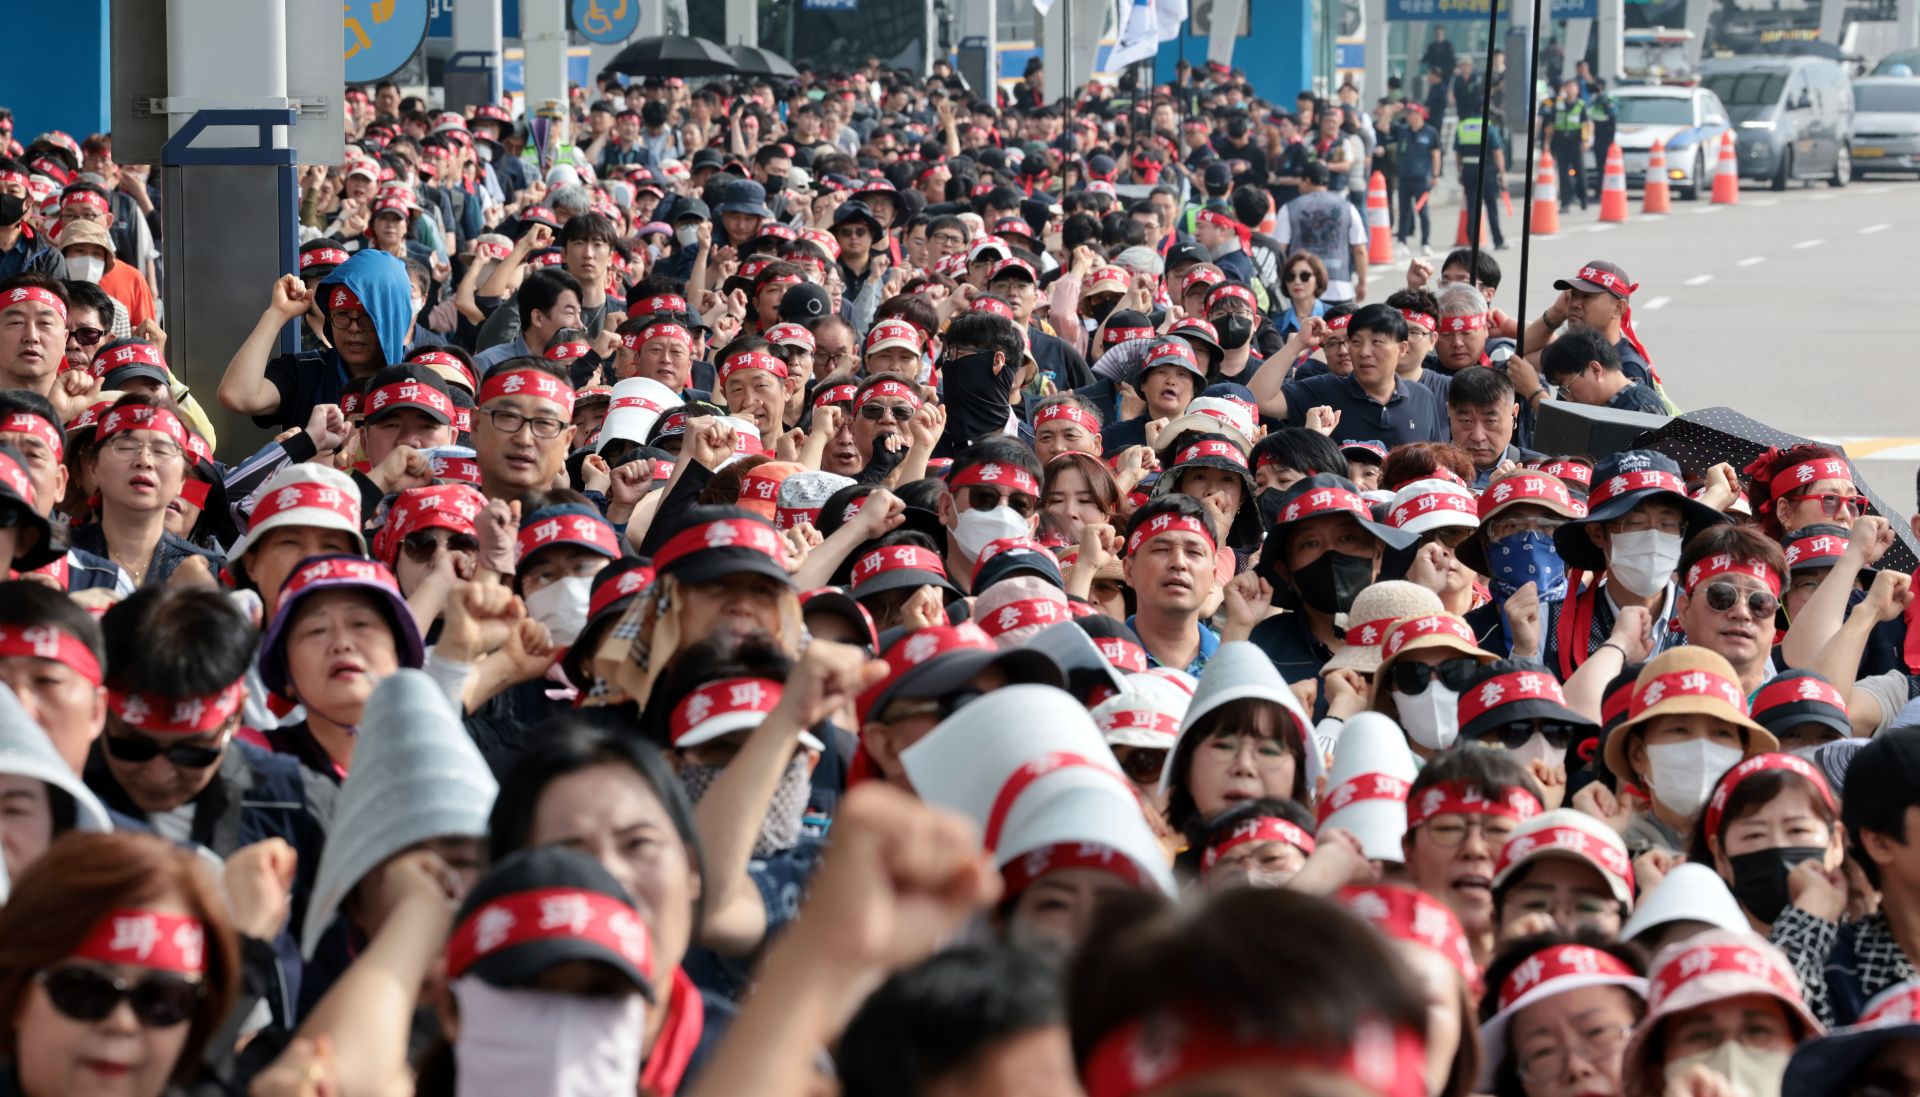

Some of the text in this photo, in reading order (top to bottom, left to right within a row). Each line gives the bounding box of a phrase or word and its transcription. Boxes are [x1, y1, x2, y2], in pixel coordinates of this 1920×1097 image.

[1583, 267, 1615, 286] 파업
[873, 327, 918, 344] 총파업
[94, 346, 160, 377] 총파업
[721, 352, 776, 377] 총파업
[1144, 344, 1188, 364] 총파업
[373, 384, 446, 410] 총파업
[861, 380, 920, 407] 총파업
[103, 407, 182, 441] 총파업
[1185, 442, 1246, 466] 총파업
[1619, 461, 1651, 473] FONDEST
[979, 462, 1040, 497] 총파
[1547, 463, 1588, 480] 파업
[1285, 490, 1364, 522] 총파업
[1493, 477, 1569, 507] 총파업
[1394, 494, 1467, 527] 총파업
[1129, 512, 1202, 550] 총파업
[1688, 553, 1767, 586] 총파업
[1390, 617, 1471, 655] 총파업
[1644, 671, 1741, 710] 총파업
[1710, 754, 1811, 811] 총파업
[1507, 830, 1629, 875] 총파업
